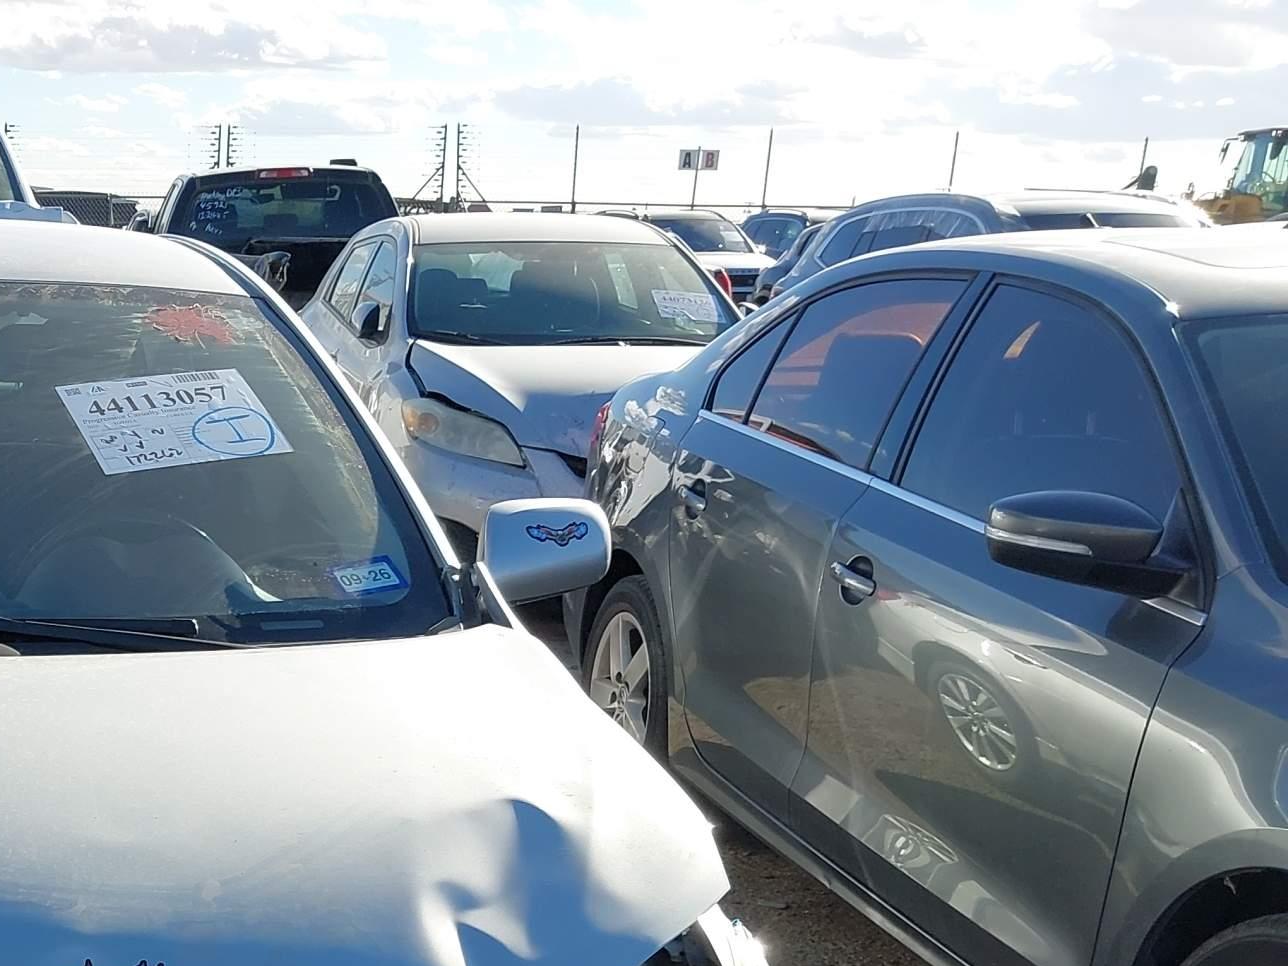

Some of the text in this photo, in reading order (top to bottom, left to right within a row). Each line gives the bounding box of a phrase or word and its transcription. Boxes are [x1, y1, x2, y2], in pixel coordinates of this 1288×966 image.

[682, 151, 715, 168] A B
[89, 385, 226, 416] 44113057
